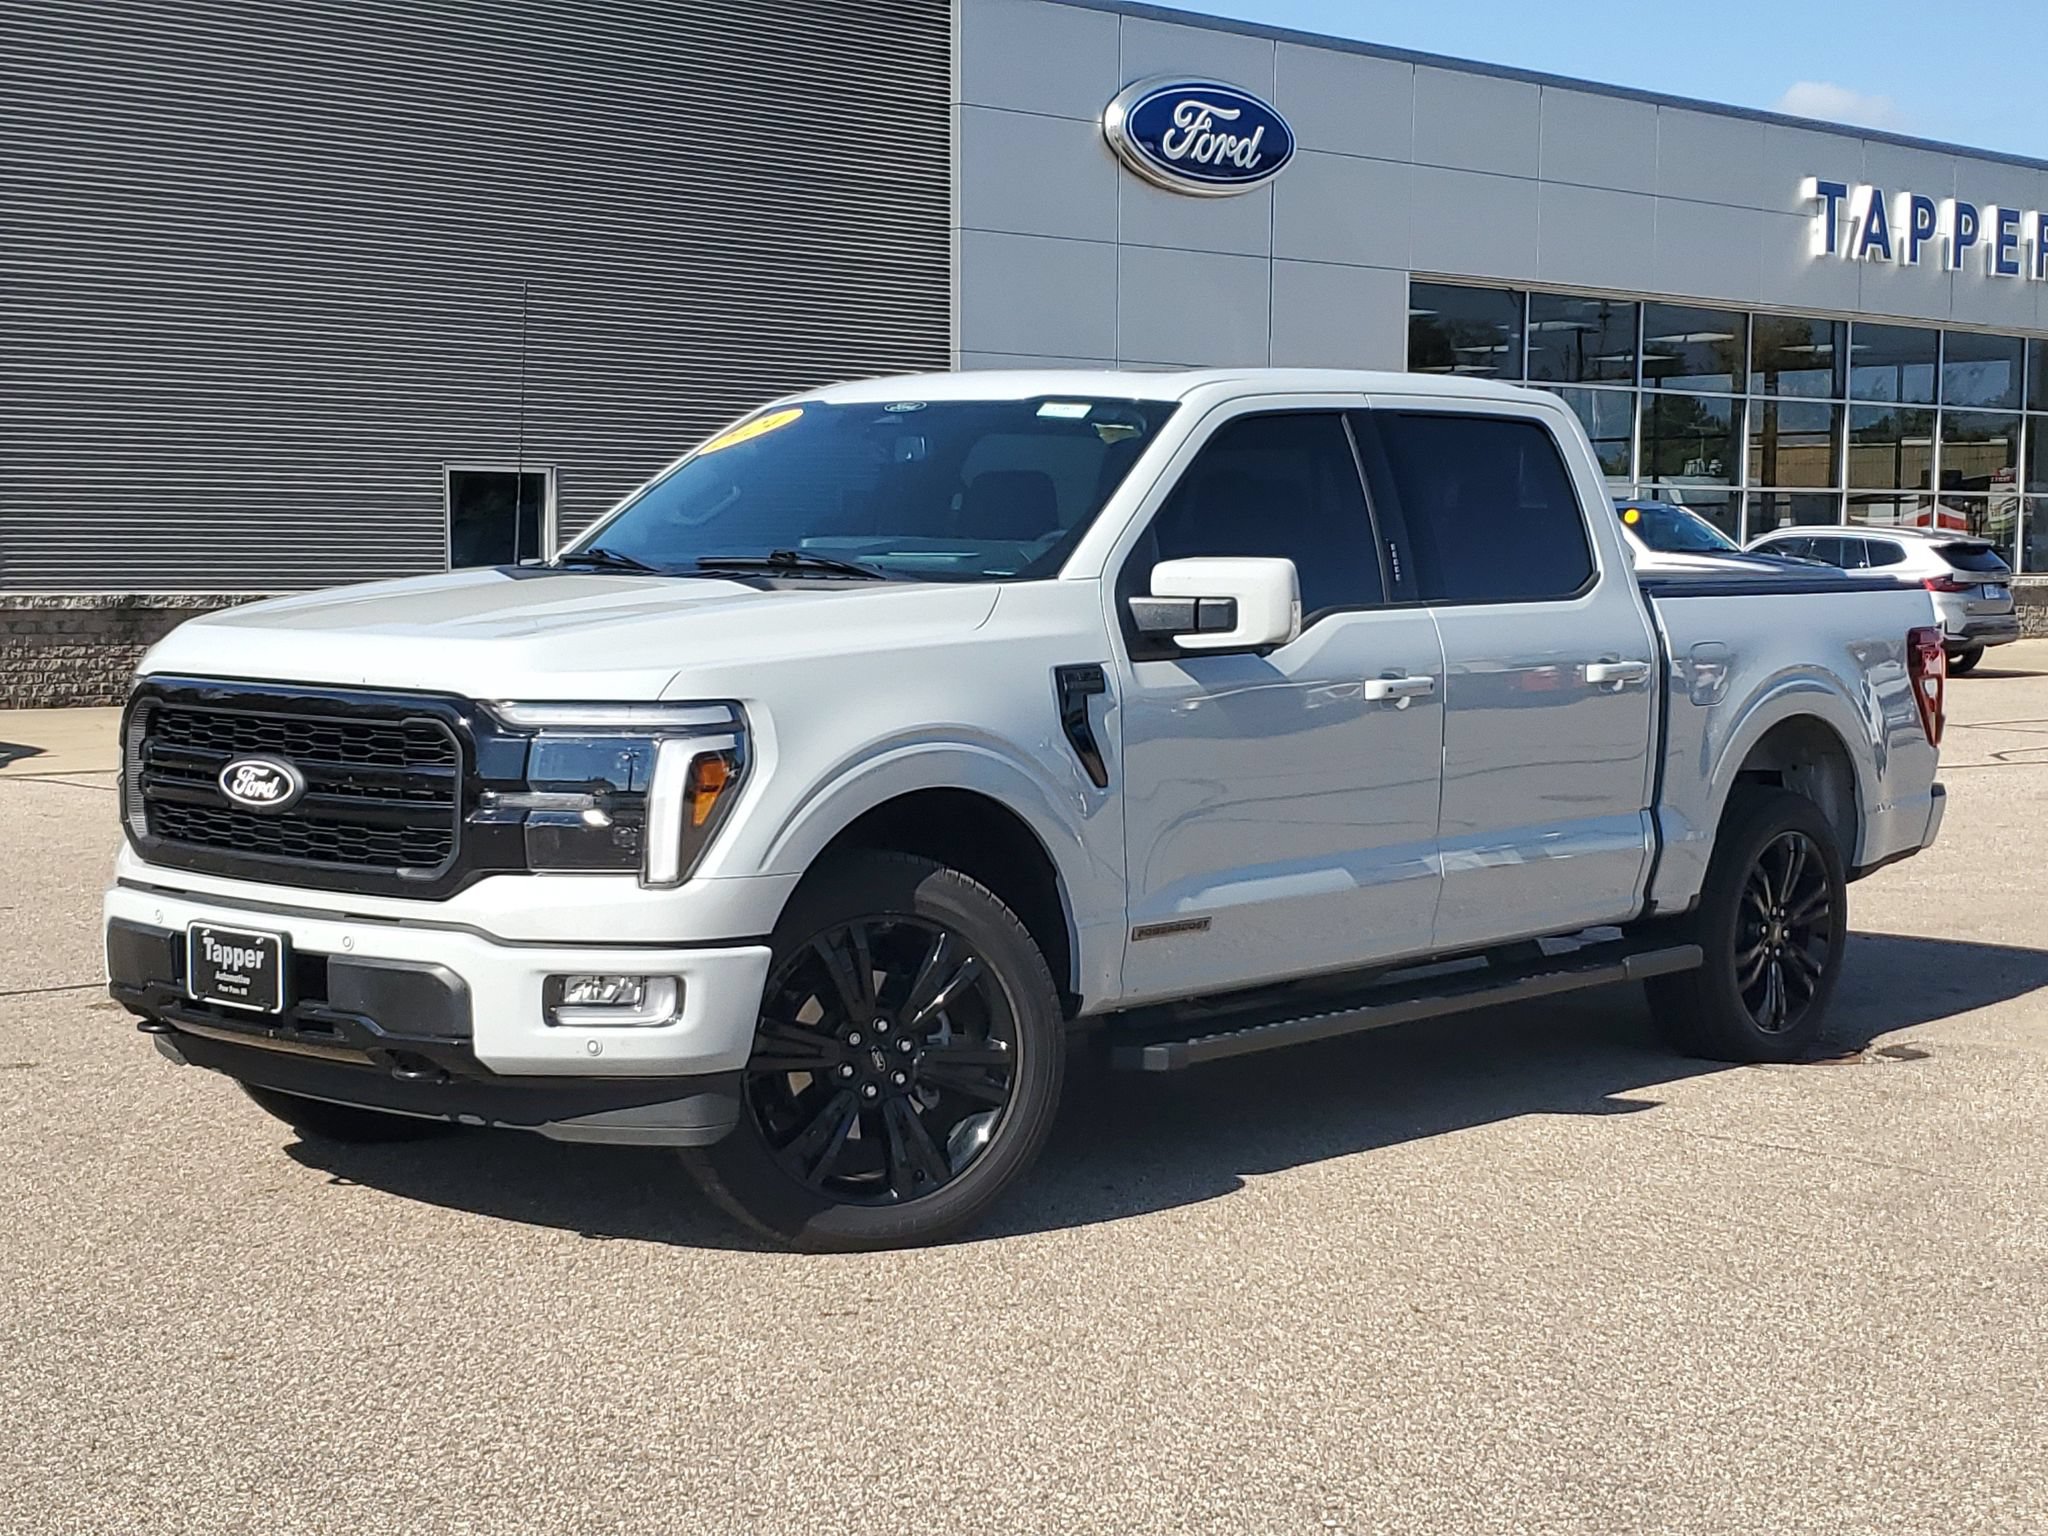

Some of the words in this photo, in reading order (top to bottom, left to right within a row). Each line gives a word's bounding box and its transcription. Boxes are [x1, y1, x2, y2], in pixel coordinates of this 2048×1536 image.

[1162, 99, 1265, 169] Ford
[232, 765, 281, 799] Ford
[202, 936, 265, 972] Tapper
